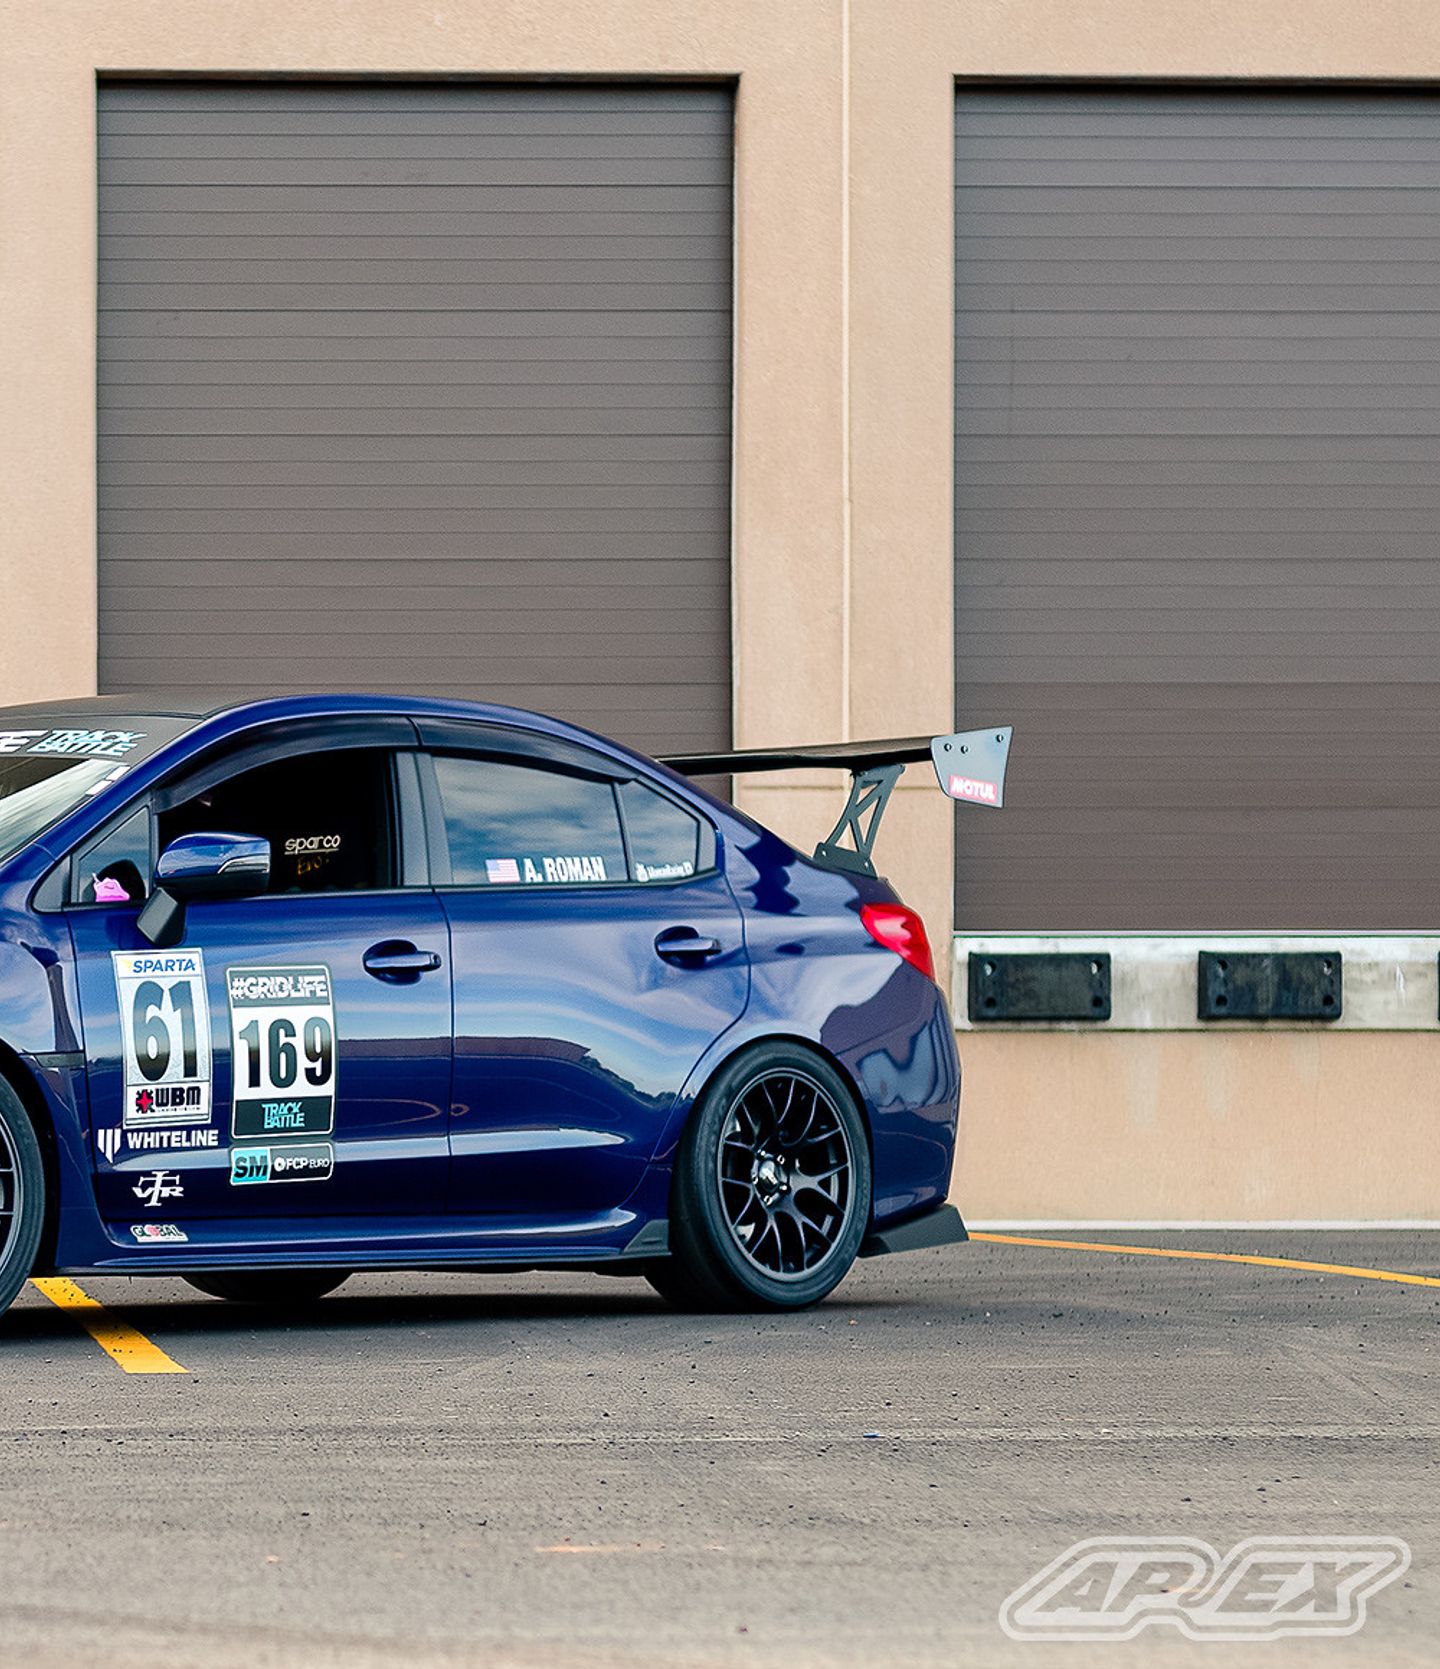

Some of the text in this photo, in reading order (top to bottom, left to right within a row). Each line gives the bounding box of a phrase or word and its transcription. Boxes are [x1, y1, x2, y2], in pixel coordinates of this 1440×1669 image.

[49, 729, 147, 743] TRACK
[26, 740, 138, 757] BATTLE
[950, 777, 996, 800] MOTUL
[523, 856, 607, 882] A. ROMAN
[132, 958, 197, 973] SPARTA
[132, 980, 198, 1082] 61
[238, 1016, 333, 1089] 169
[155, 1086, 202, 1107] WBM
[261, 1102, 303, 1116] TRACK
[264, 1113, 306, 1129] BATTLE
[127, 1129, 220, 1149] WHITELINE
[234, 1155, 269, 1178] SM
[286, 1157, 309, 1170] FCP
